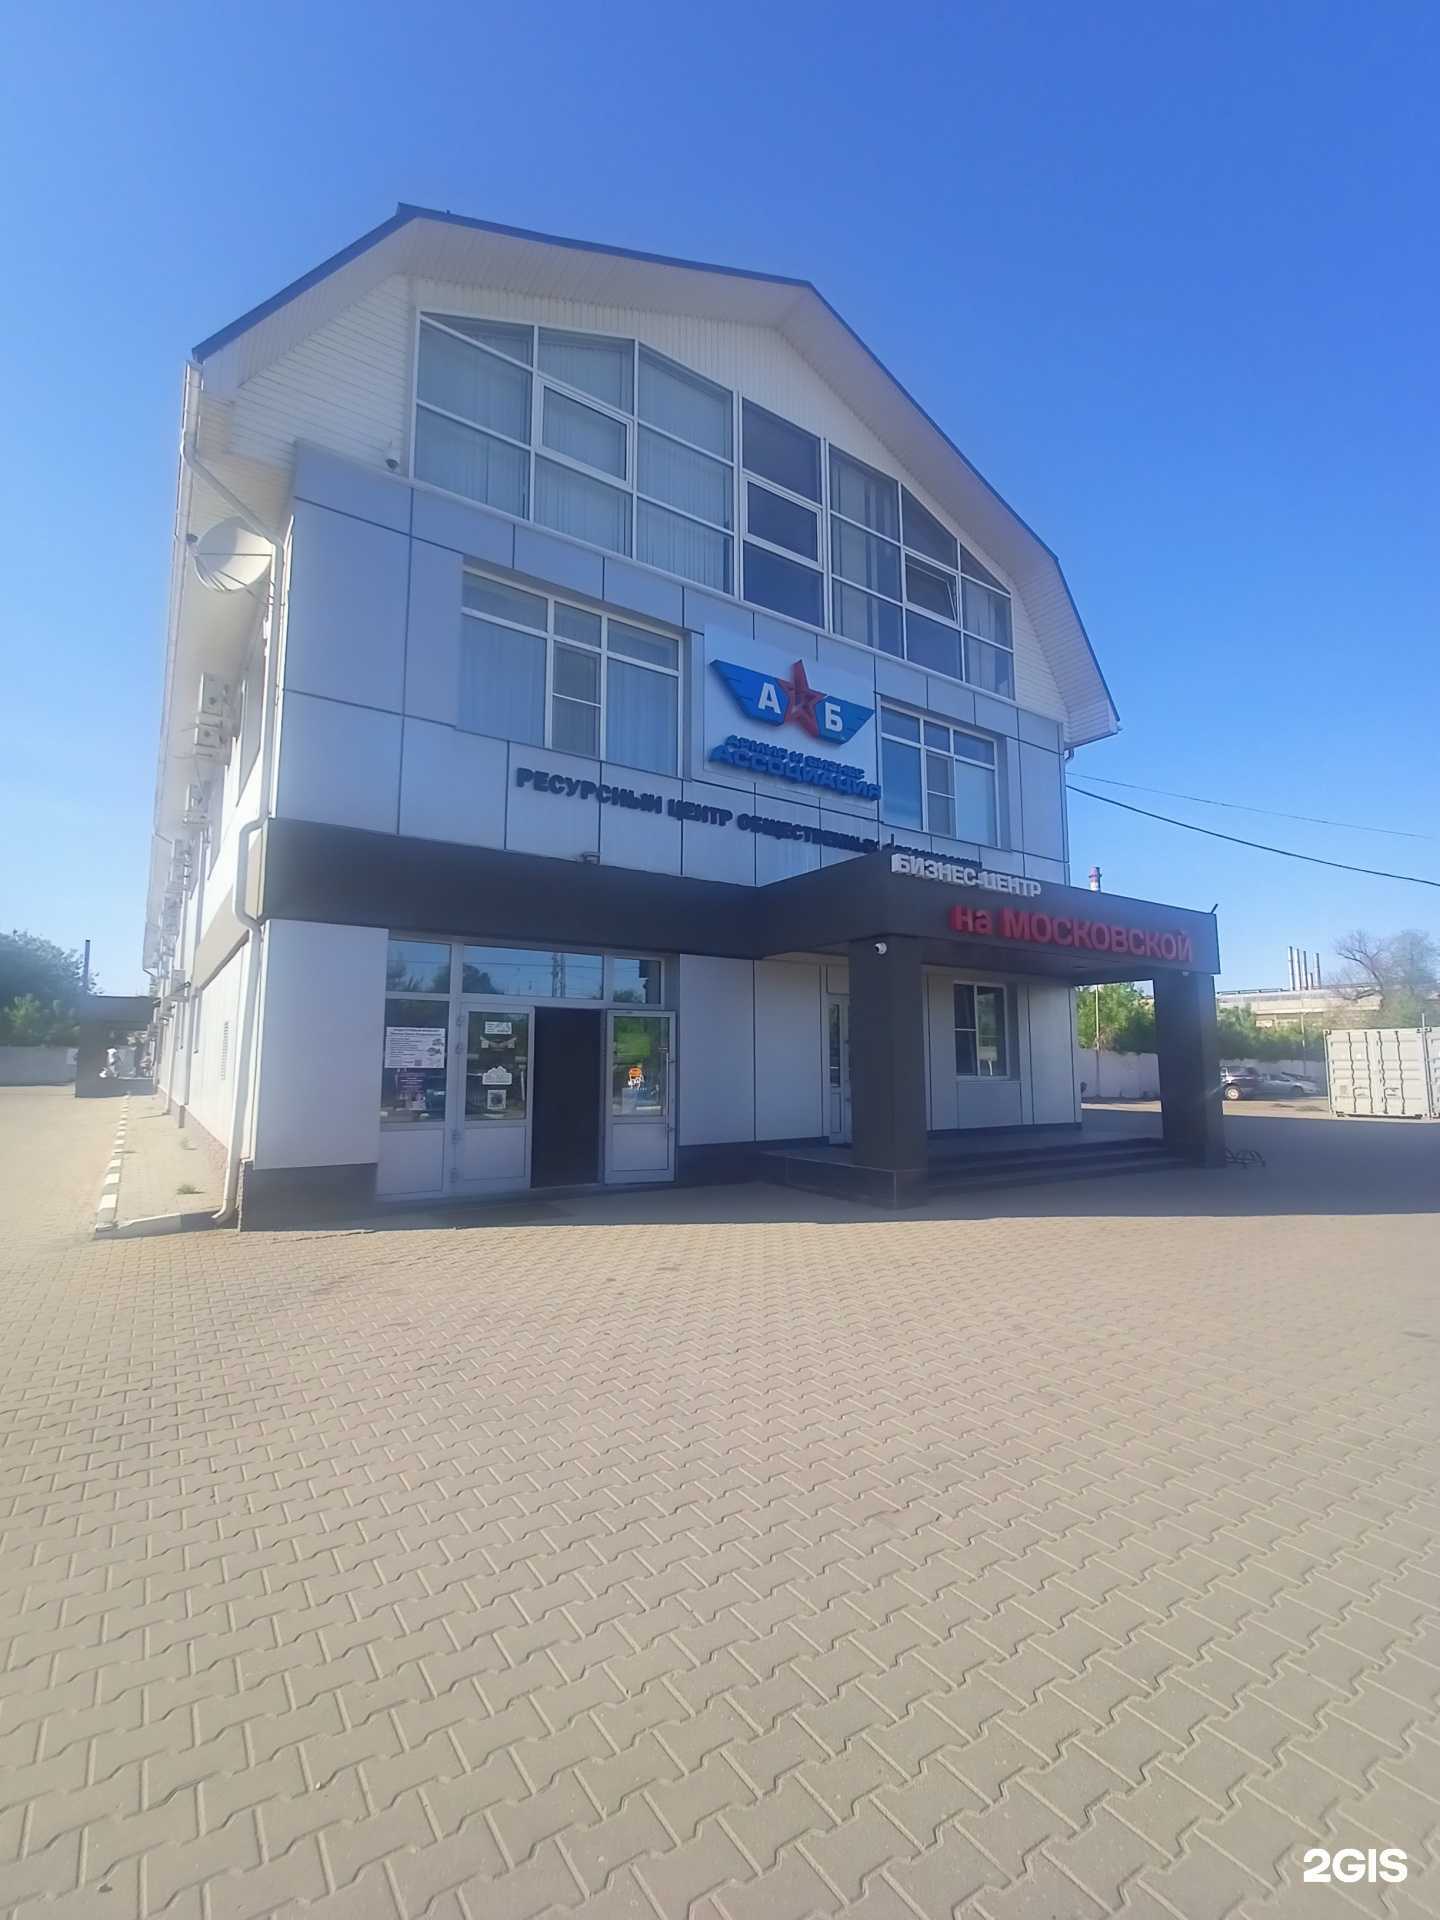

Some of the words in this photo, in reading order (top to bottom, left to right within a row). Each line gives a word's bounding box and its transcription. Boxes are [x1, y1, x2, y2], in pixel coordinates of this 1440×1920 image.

[758, 682, 781, 714] А
[824, 701, 843, 732] Б
[708, 744, 881, 801] АССОЦИАЦИЯ
[668, 799, 733, 827] ЦЕНТР
[891, 853, 1042, 898] БИЗНЕС-ЦЕНТР
[1001, 907, 1192, 962] МОСКОВСКОЙ
